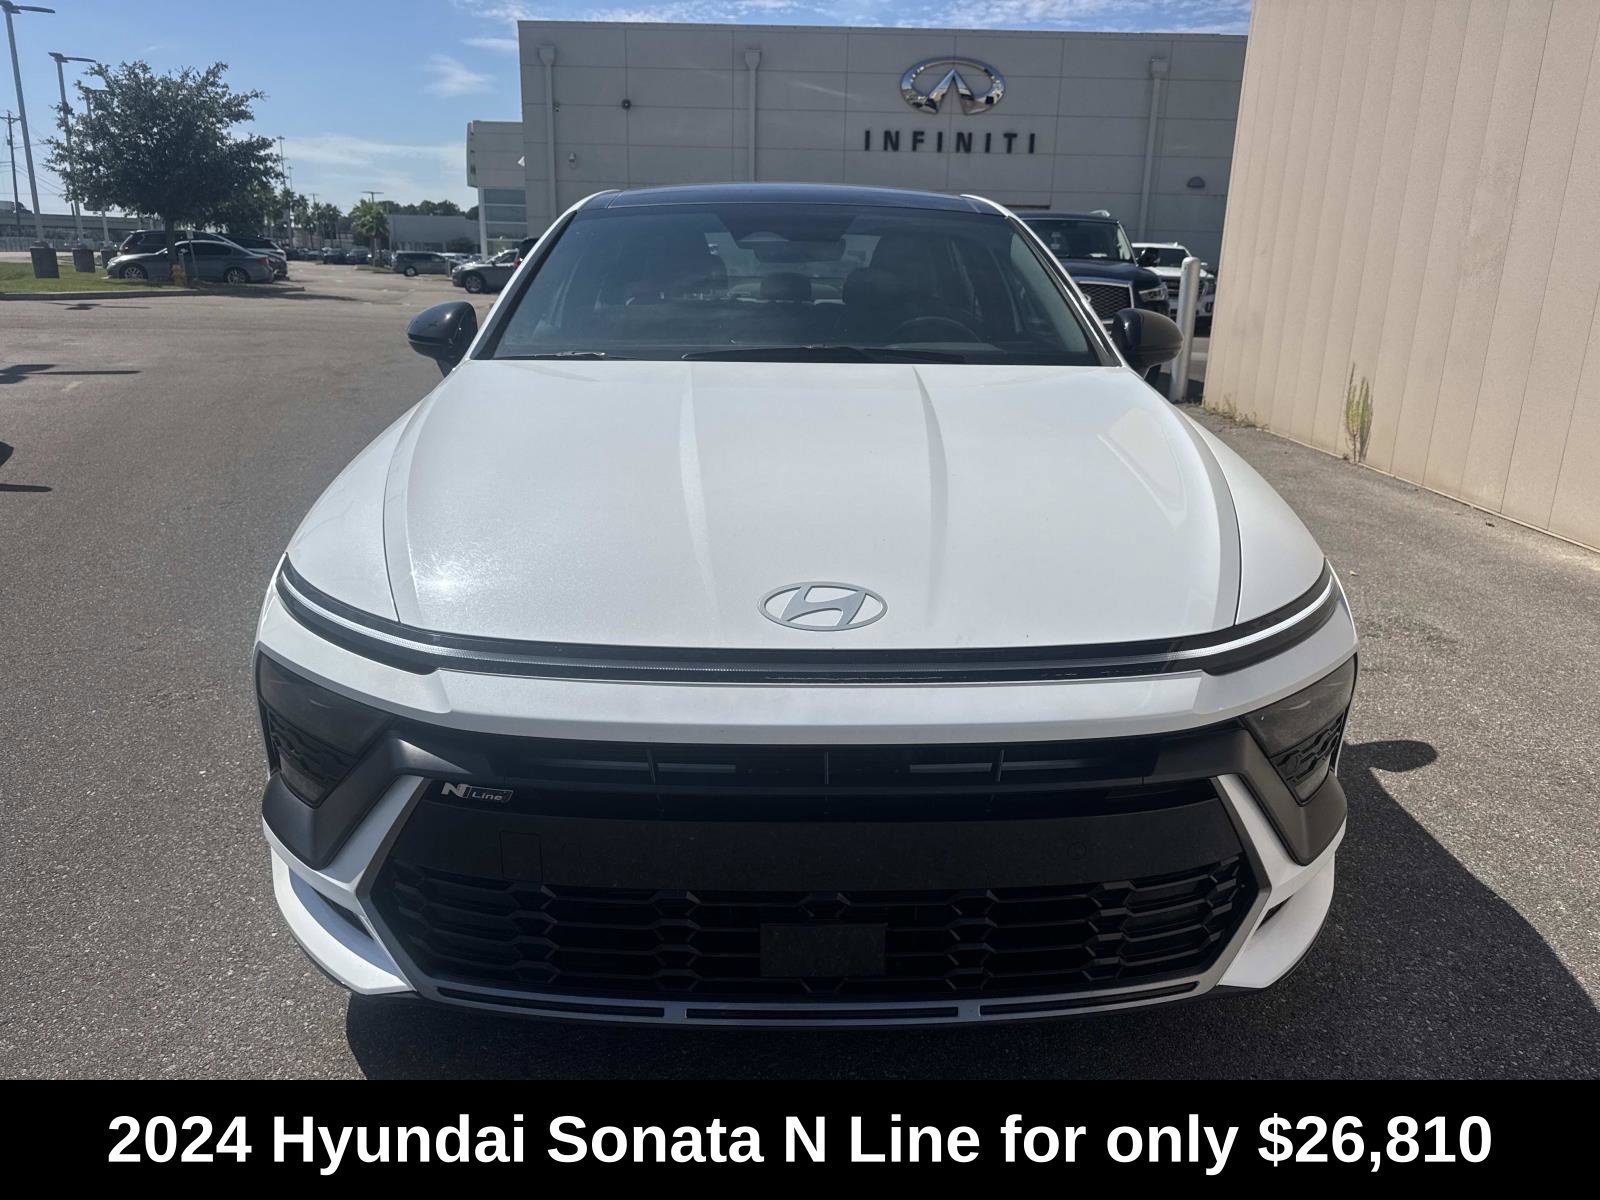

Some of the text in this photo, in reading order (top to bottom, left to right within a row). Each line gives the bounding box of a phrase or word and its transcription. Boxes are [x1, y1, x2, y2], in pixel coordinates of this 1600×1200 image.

[864, 130, 1036, 154] INFINITI
[441, 782, 503, 801] N Line
